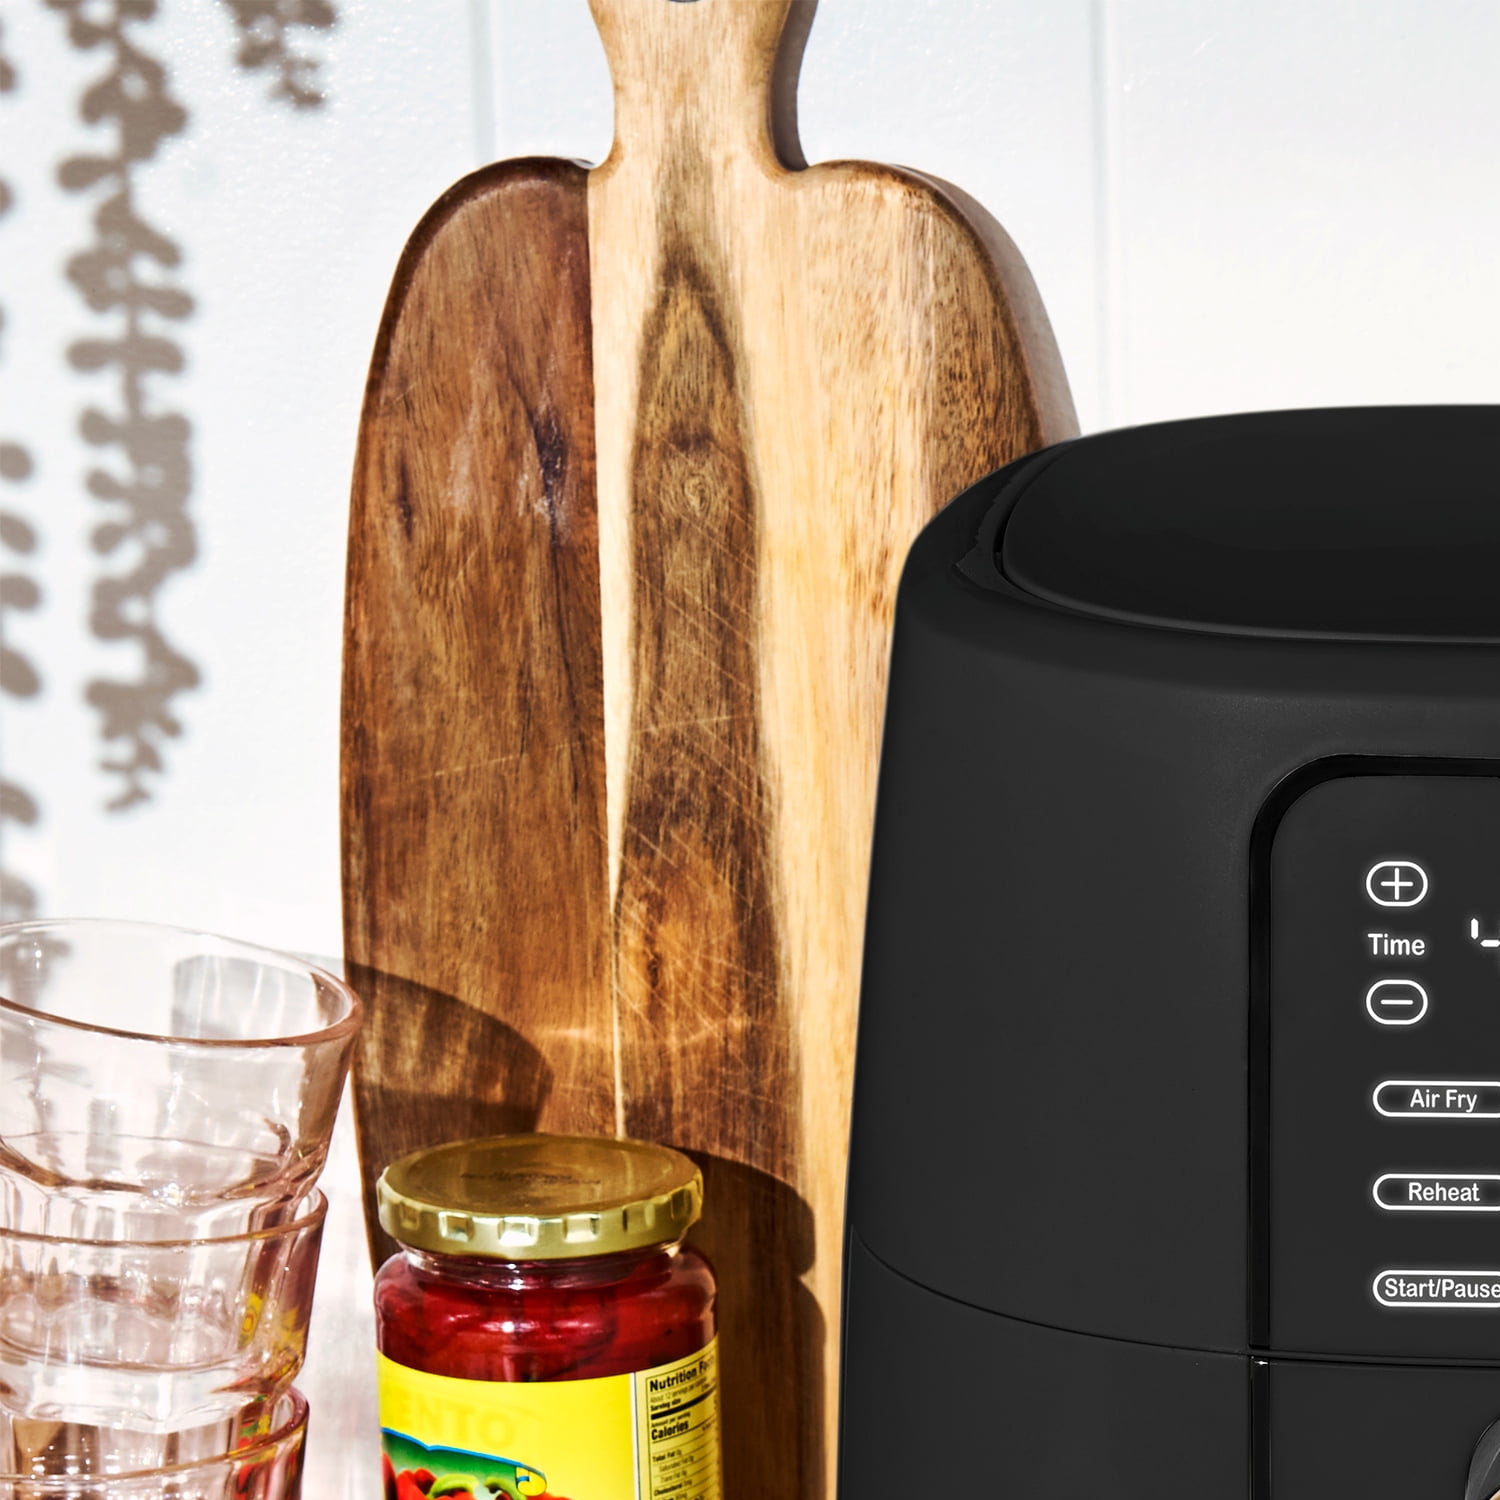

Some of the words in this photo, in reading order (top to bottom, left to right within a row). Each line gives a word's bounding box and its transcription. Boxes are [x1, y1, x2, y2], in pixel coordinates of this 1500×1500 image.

[1368, 933, 1425, 956] Time
[1409, 1088, 1440, 1109] Air
[1445, 1090, 1478, 1113] Fry
[1408, 1182, 1480, 1202] Reheat
[650, 1366, 697, 1392] Nutrition
[651, 1420, 689, 1440] Calories
